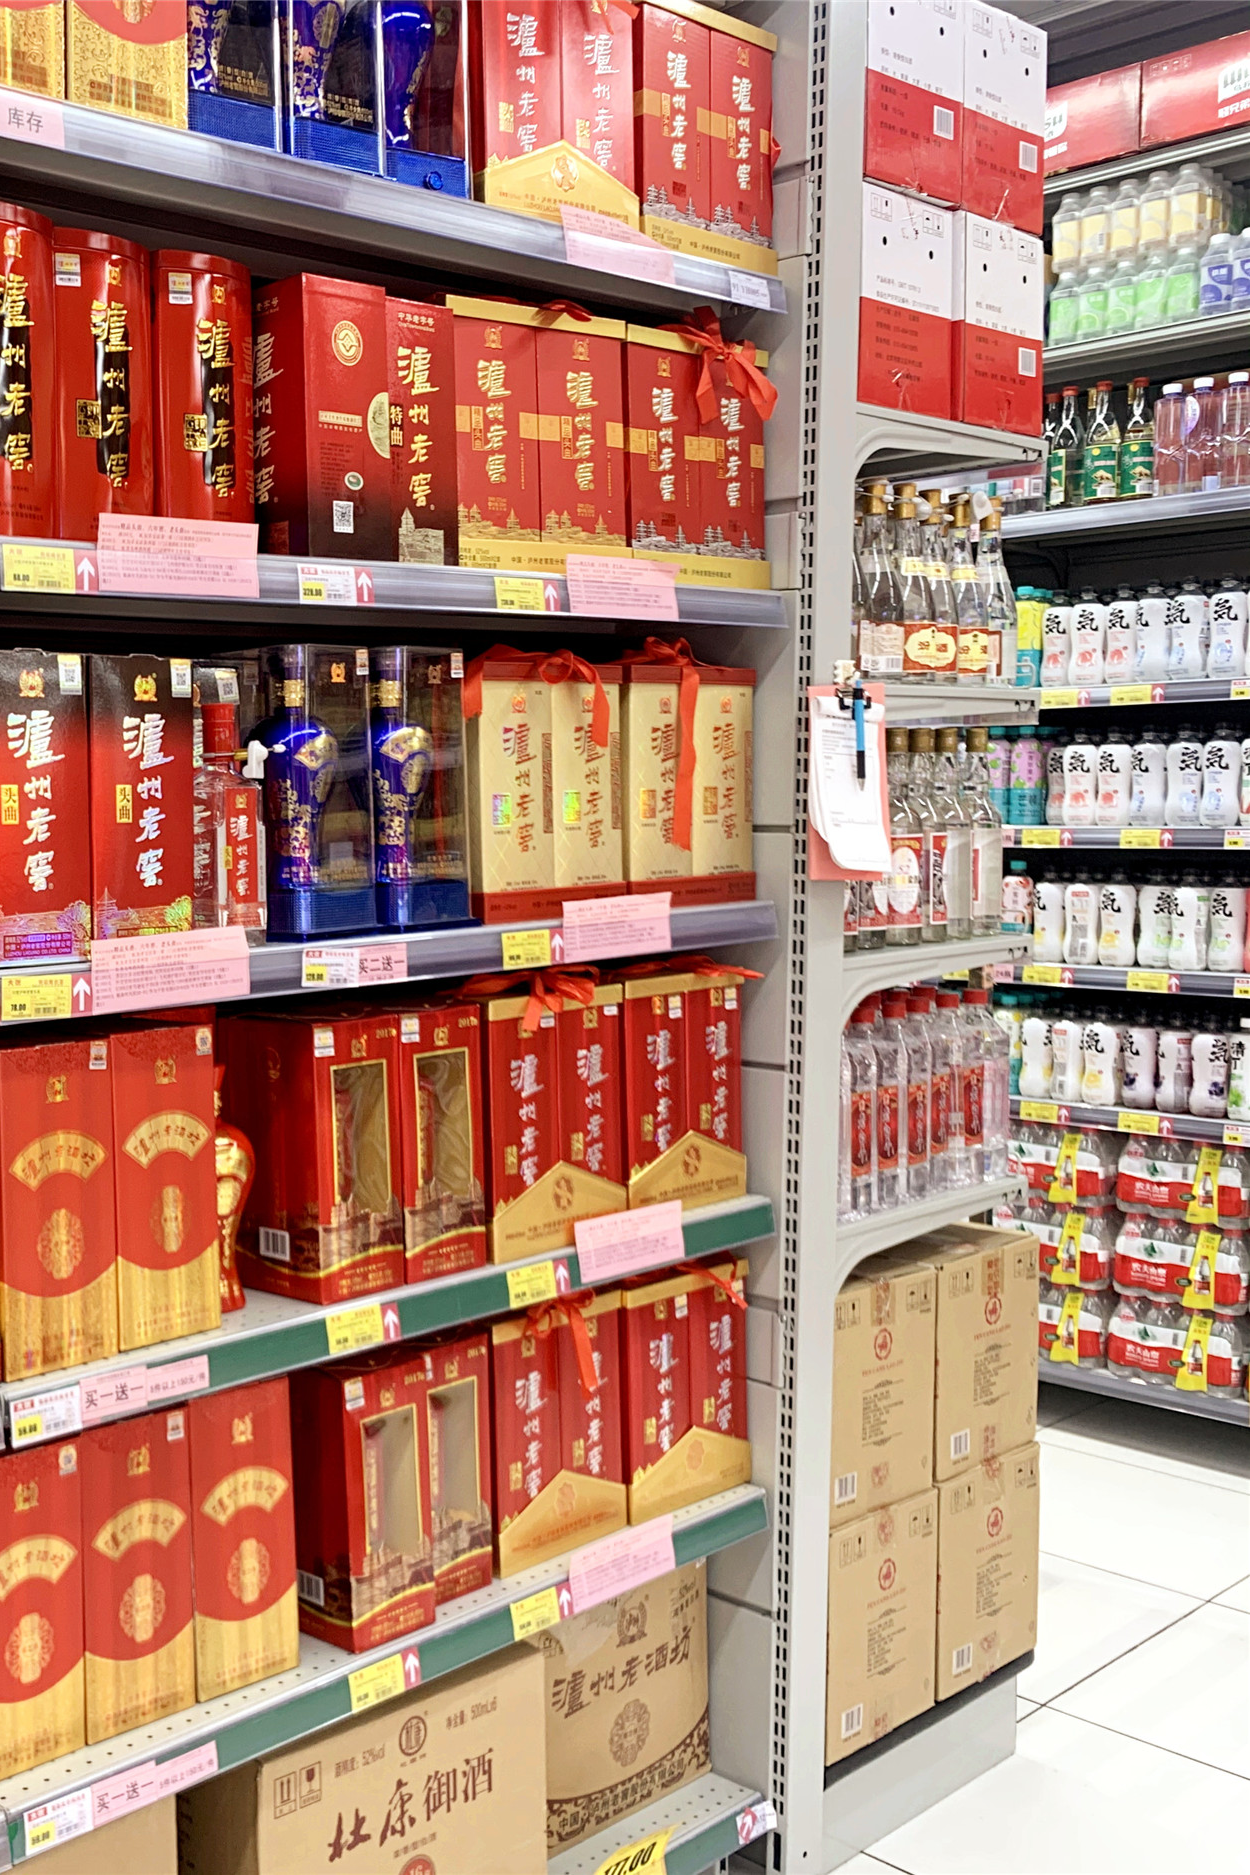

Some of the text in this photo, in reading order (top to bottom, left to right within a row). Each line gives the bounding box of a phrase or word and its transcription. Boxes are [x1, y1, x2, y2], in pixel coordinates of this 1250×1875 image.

[8, 106, 44, 134] 库存
[506, 12, 545, 153] 泸州老窖
[583, 33, 620, 169] 泸州老窖
[666, 51, 692, 170] 泸州老窖
[731, 75, 755, 191] 泸州老窖
[91, 299, 134, 488] 泸州老窖
[197, 318, 236, 498] 泸州老窖
[390, 405, 403, 447] 特曲
[396, 345, 441, 509] 泸州老窖
[477, 359, 512, 485] 泸州老窖
[566, 370, 599, 492] 泸州老窖
[651, 387, 679, 502] 泸州老窖
[720, 397, 745, 508] 泸州老窖
[3, 786, 18, 823] 头曲
[6, 709, 66, 892] 泸州老窖
[118, 786, 131, 821] 头曲
[122, 713, 175, 888] 泸州老窖
[230, 814, 254, 897] 泸州老窖
[510, 1053, 546, 1188] 泸州老窖
[577, 1043, 610, 1173] 泸州老窖
[646, 1028, 676, 1154] 泸州老窖
[704, 1019, 733, 1140] 泸州老窖
[84, 1383, 144, 1410] 买一送一
[649, 1331, 679, 1454] 泸州老窖
[709, 1313, 733, 1431] 泸州老窖
[515, 1370, 548, 1500] 泸州老窖
[551, 1624, 694, 1720] 泸州老酒坊
[96, 1780, 154, 1813] 买一送一
[327, 1746, 495, 1863] 杜康御酒
